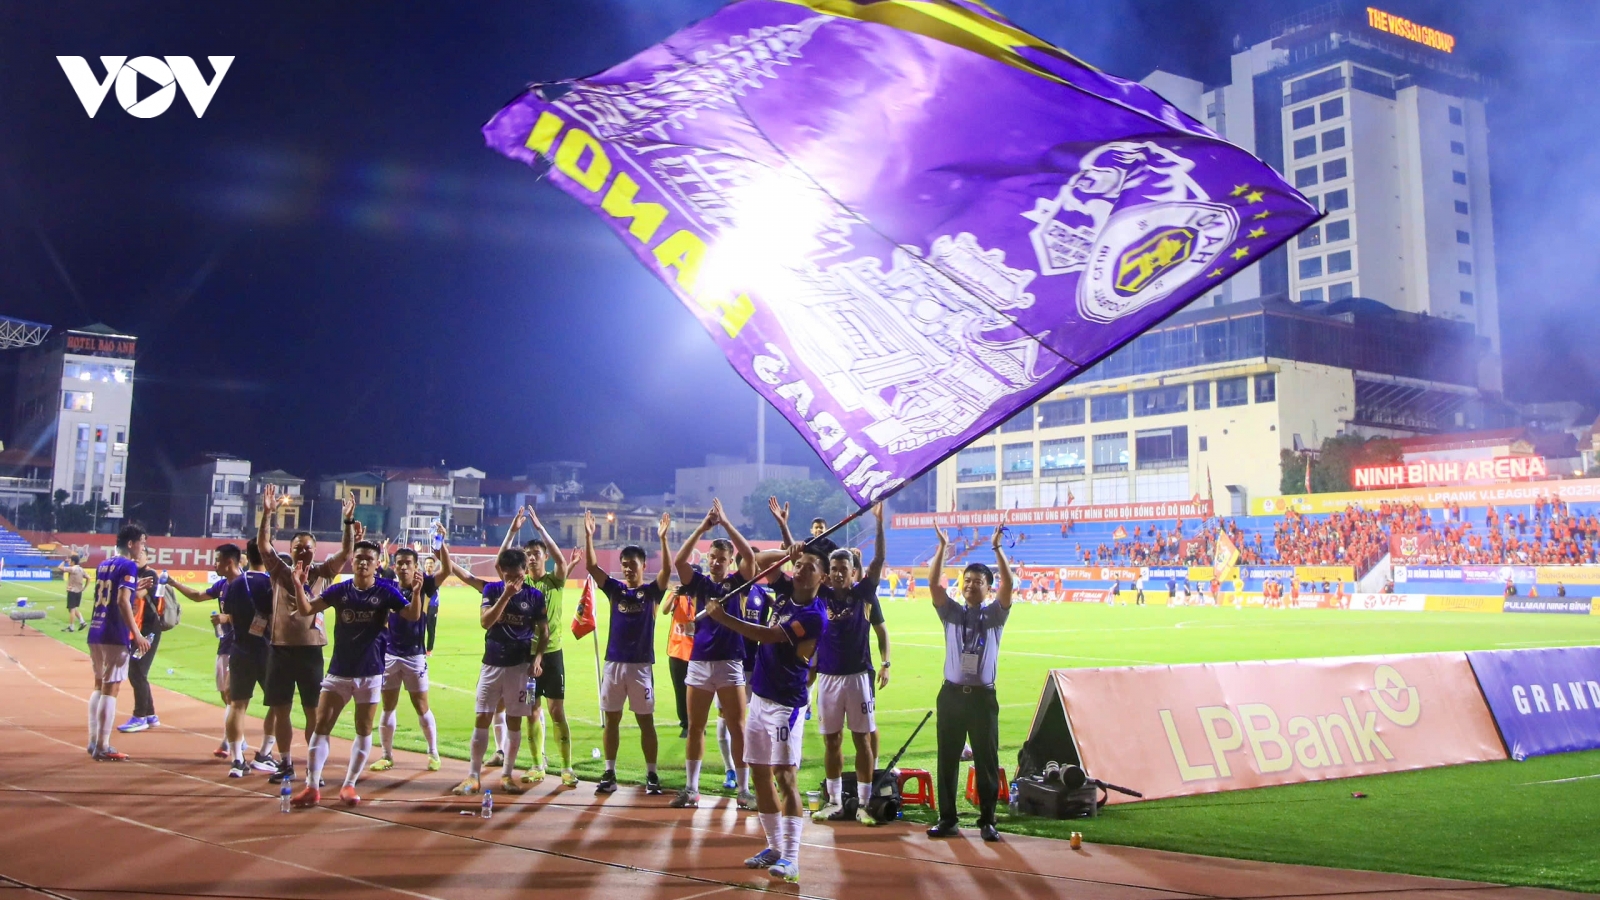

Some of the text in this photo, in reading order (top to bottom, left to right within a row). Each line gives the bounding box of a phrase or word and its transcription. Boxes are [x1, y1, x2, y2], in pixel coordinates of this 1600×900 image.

[1366, 6, 1455, 54] THE VISSAI GROUP
[68, 336, 96, 350] HOTEL
[118, 342, 136, 354] ANH
[1354, 456, 1546, 486] NINH BÌNH ARENA
[896, 515, 902, 526] VÌ
[1012, 512, 1032, 522] CHUNG
[1033, 511, 1044, 521] TAY
[1084, 508, 1102, 519] MÌNH
[1104, 508, 1118, 518] CHO
[1134, 504, 1154, 518] BÓNG
[1180, 504, 1195, 515] HOA
[1068, 570, 1092, 580] FPT Play
[1122, 570, 1136, 580] Play
[1380, 595, 1408, 606] VPF
[1504, 602, 1546, 610] PULLMAN
[1568, 601, 1590, 610] BÌNH
[644, 688, 653, 700] 21
[1512, 681, 1600, 714] GRAND
[861, 702, 872, 714] 80
[776, 726, 788, 742] 10
[1158, 696, 1395, 782] LPBank
